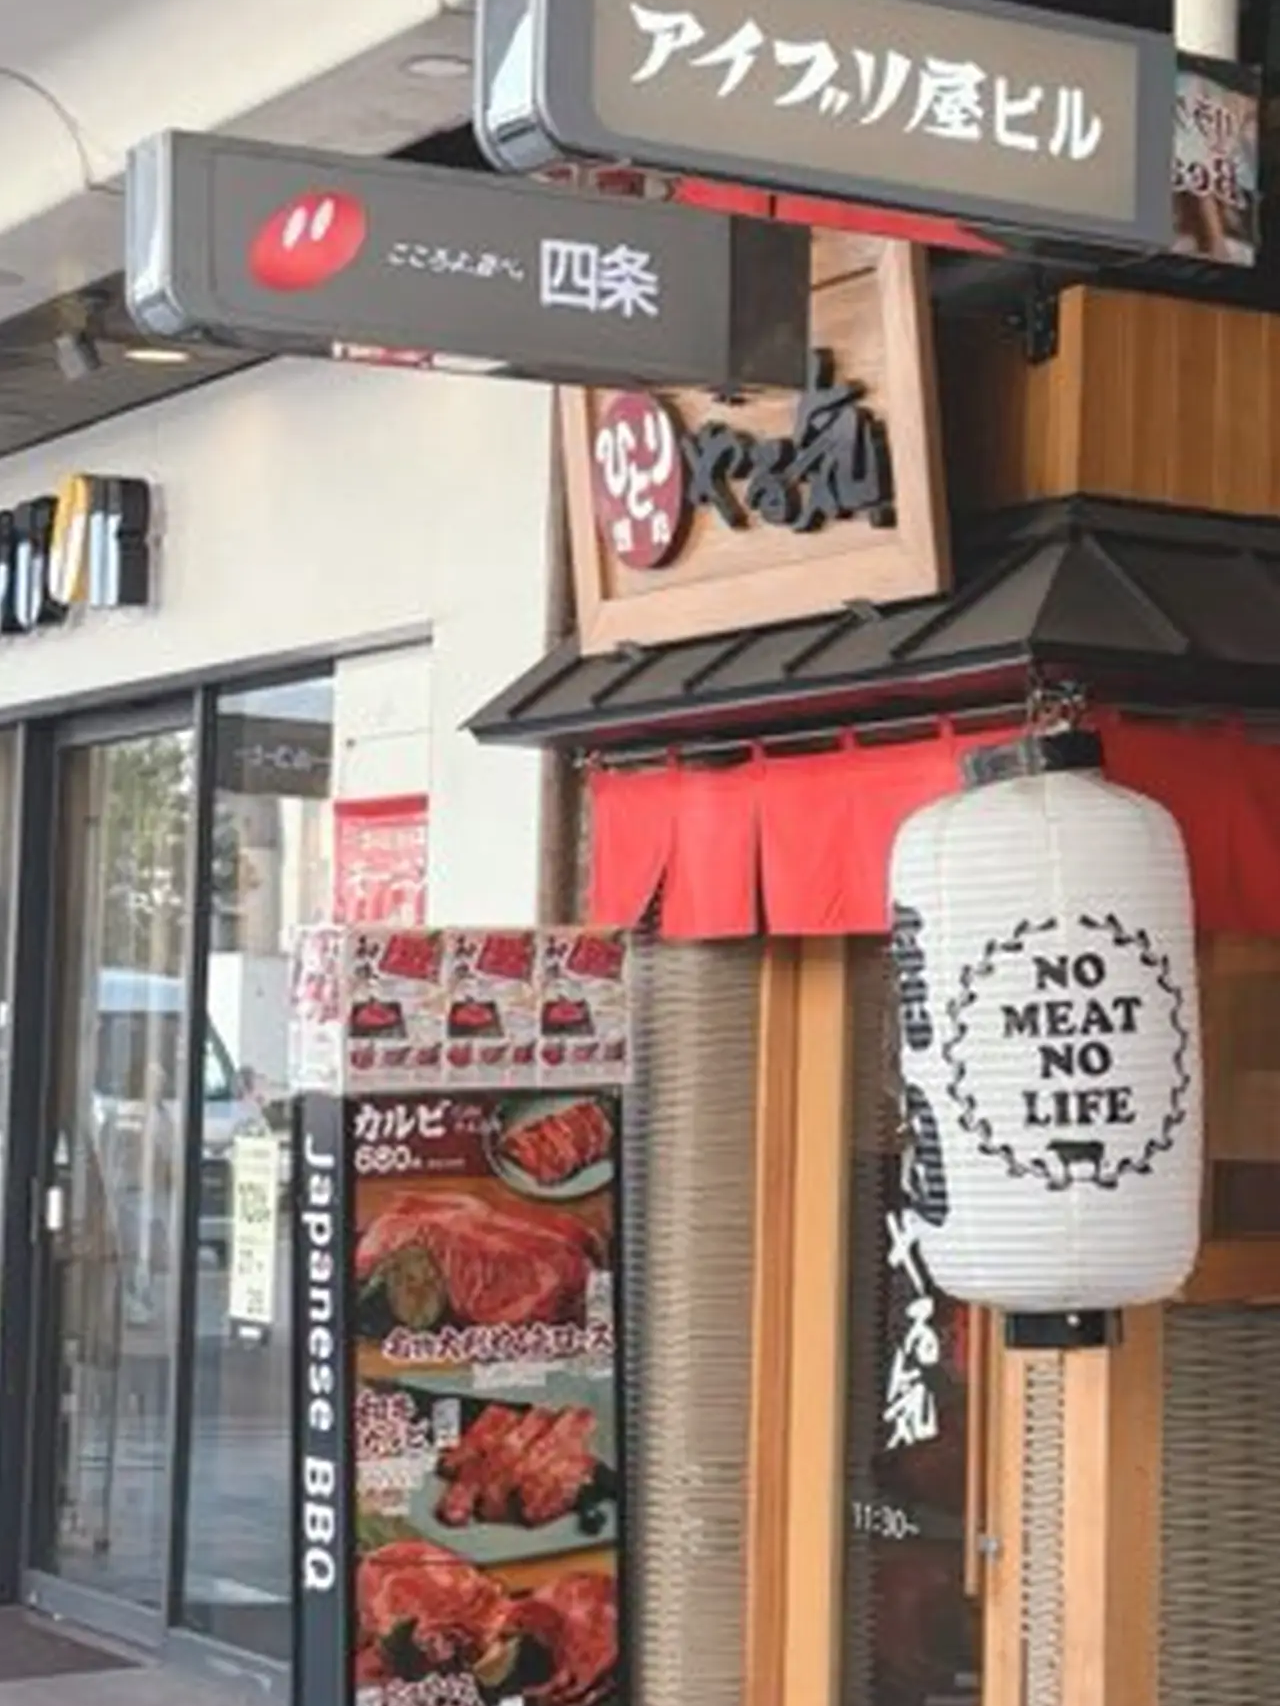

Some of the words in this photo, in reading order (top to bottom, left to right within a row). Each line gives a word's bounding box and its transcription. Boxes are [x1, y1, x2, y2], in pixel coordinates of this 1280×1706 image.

[629, 2, 1102, 160] アイブリ屋ビル
[540, 239, 659, 318] 四条
[1033, 953, 1105, 989] NO
[1002, 996, 1142, 1038] MEAT
[1038, 1043, 1113, 1079] NO
[354, 1099, 452, 1142] カルビ
[1022, 1087, 1137, 1126] LIFE
[300, 1135, 336, 1432] Japanese
[303, 1458, 337, 1590] BBQ
